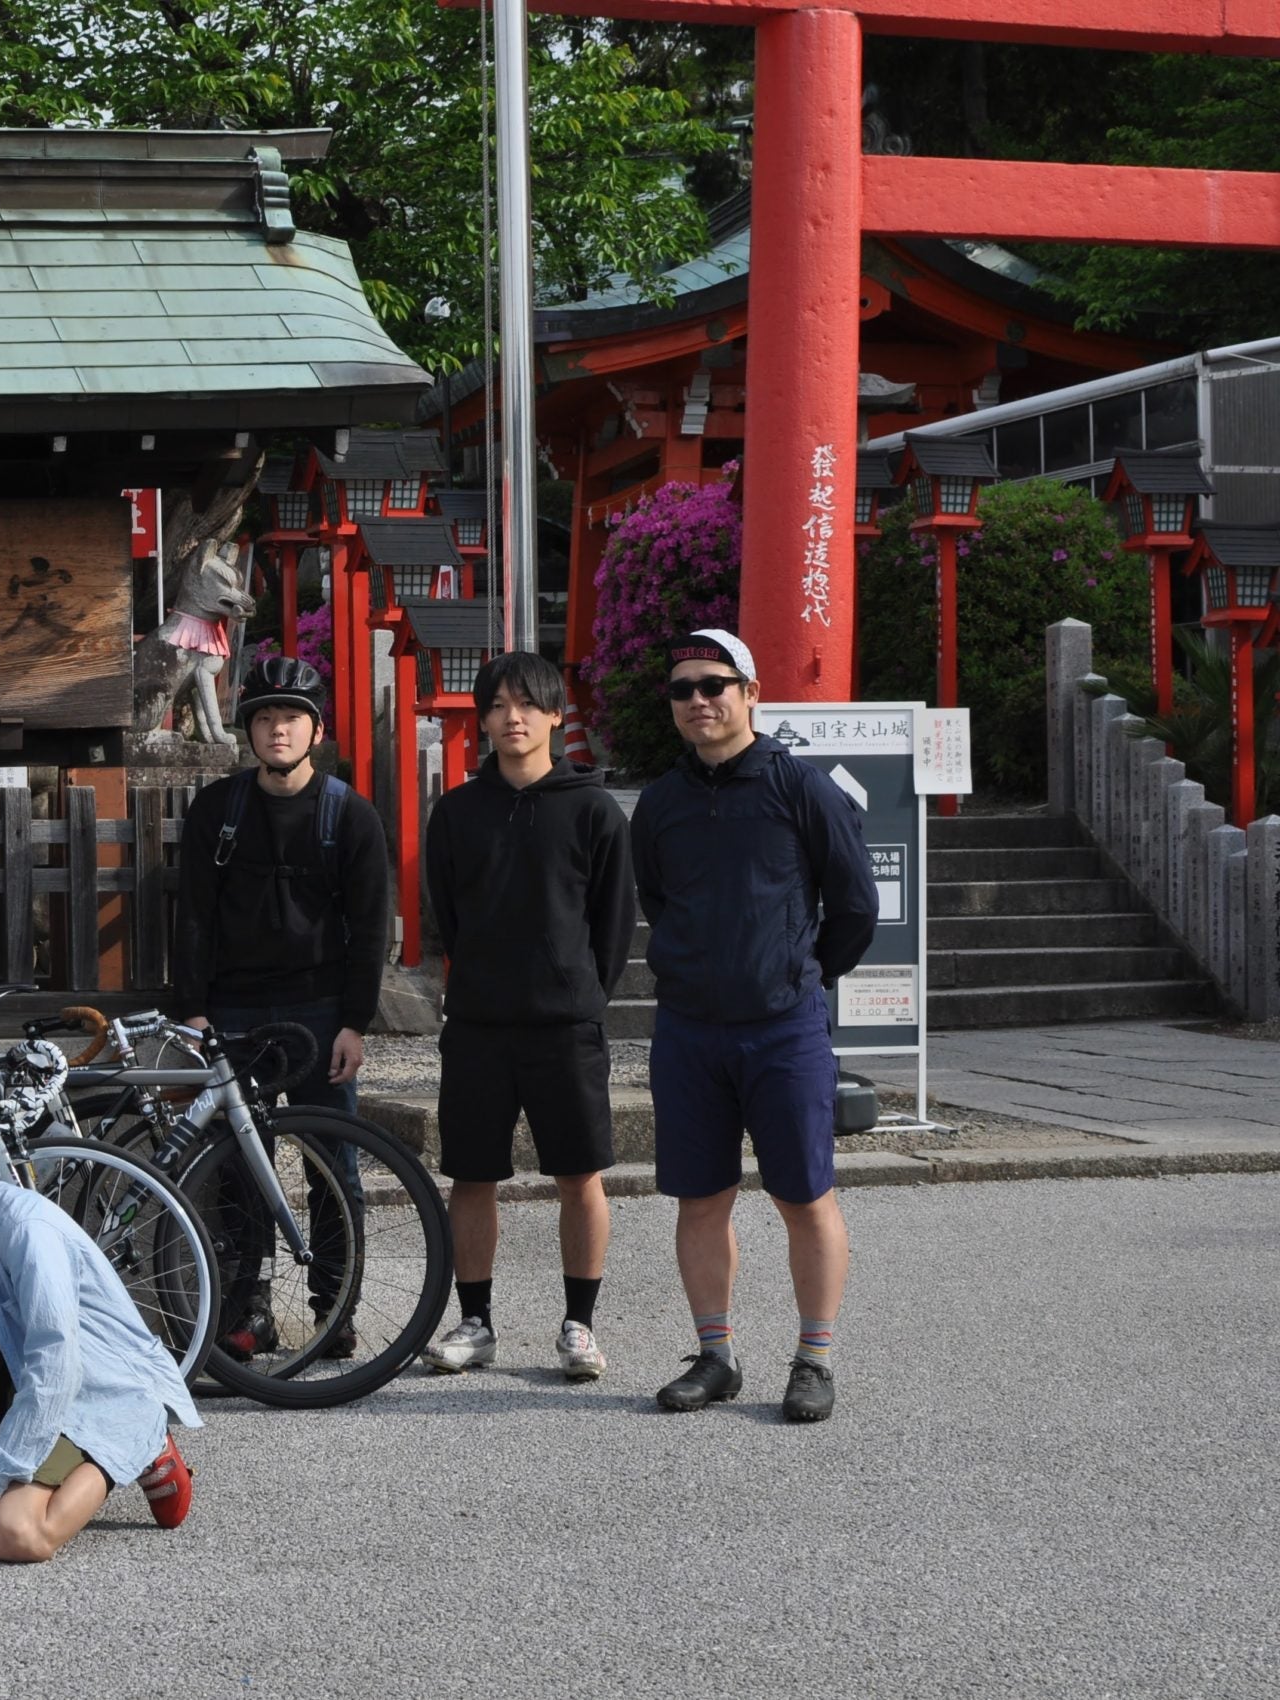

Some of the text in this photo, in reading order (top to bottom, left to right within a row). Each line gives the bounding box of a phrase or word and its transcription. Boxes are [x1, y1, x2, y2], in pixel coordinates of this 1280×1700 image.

[811, 720, 910, 739] 国宝犬山城
[870, 851, 900, 863] 守入場
